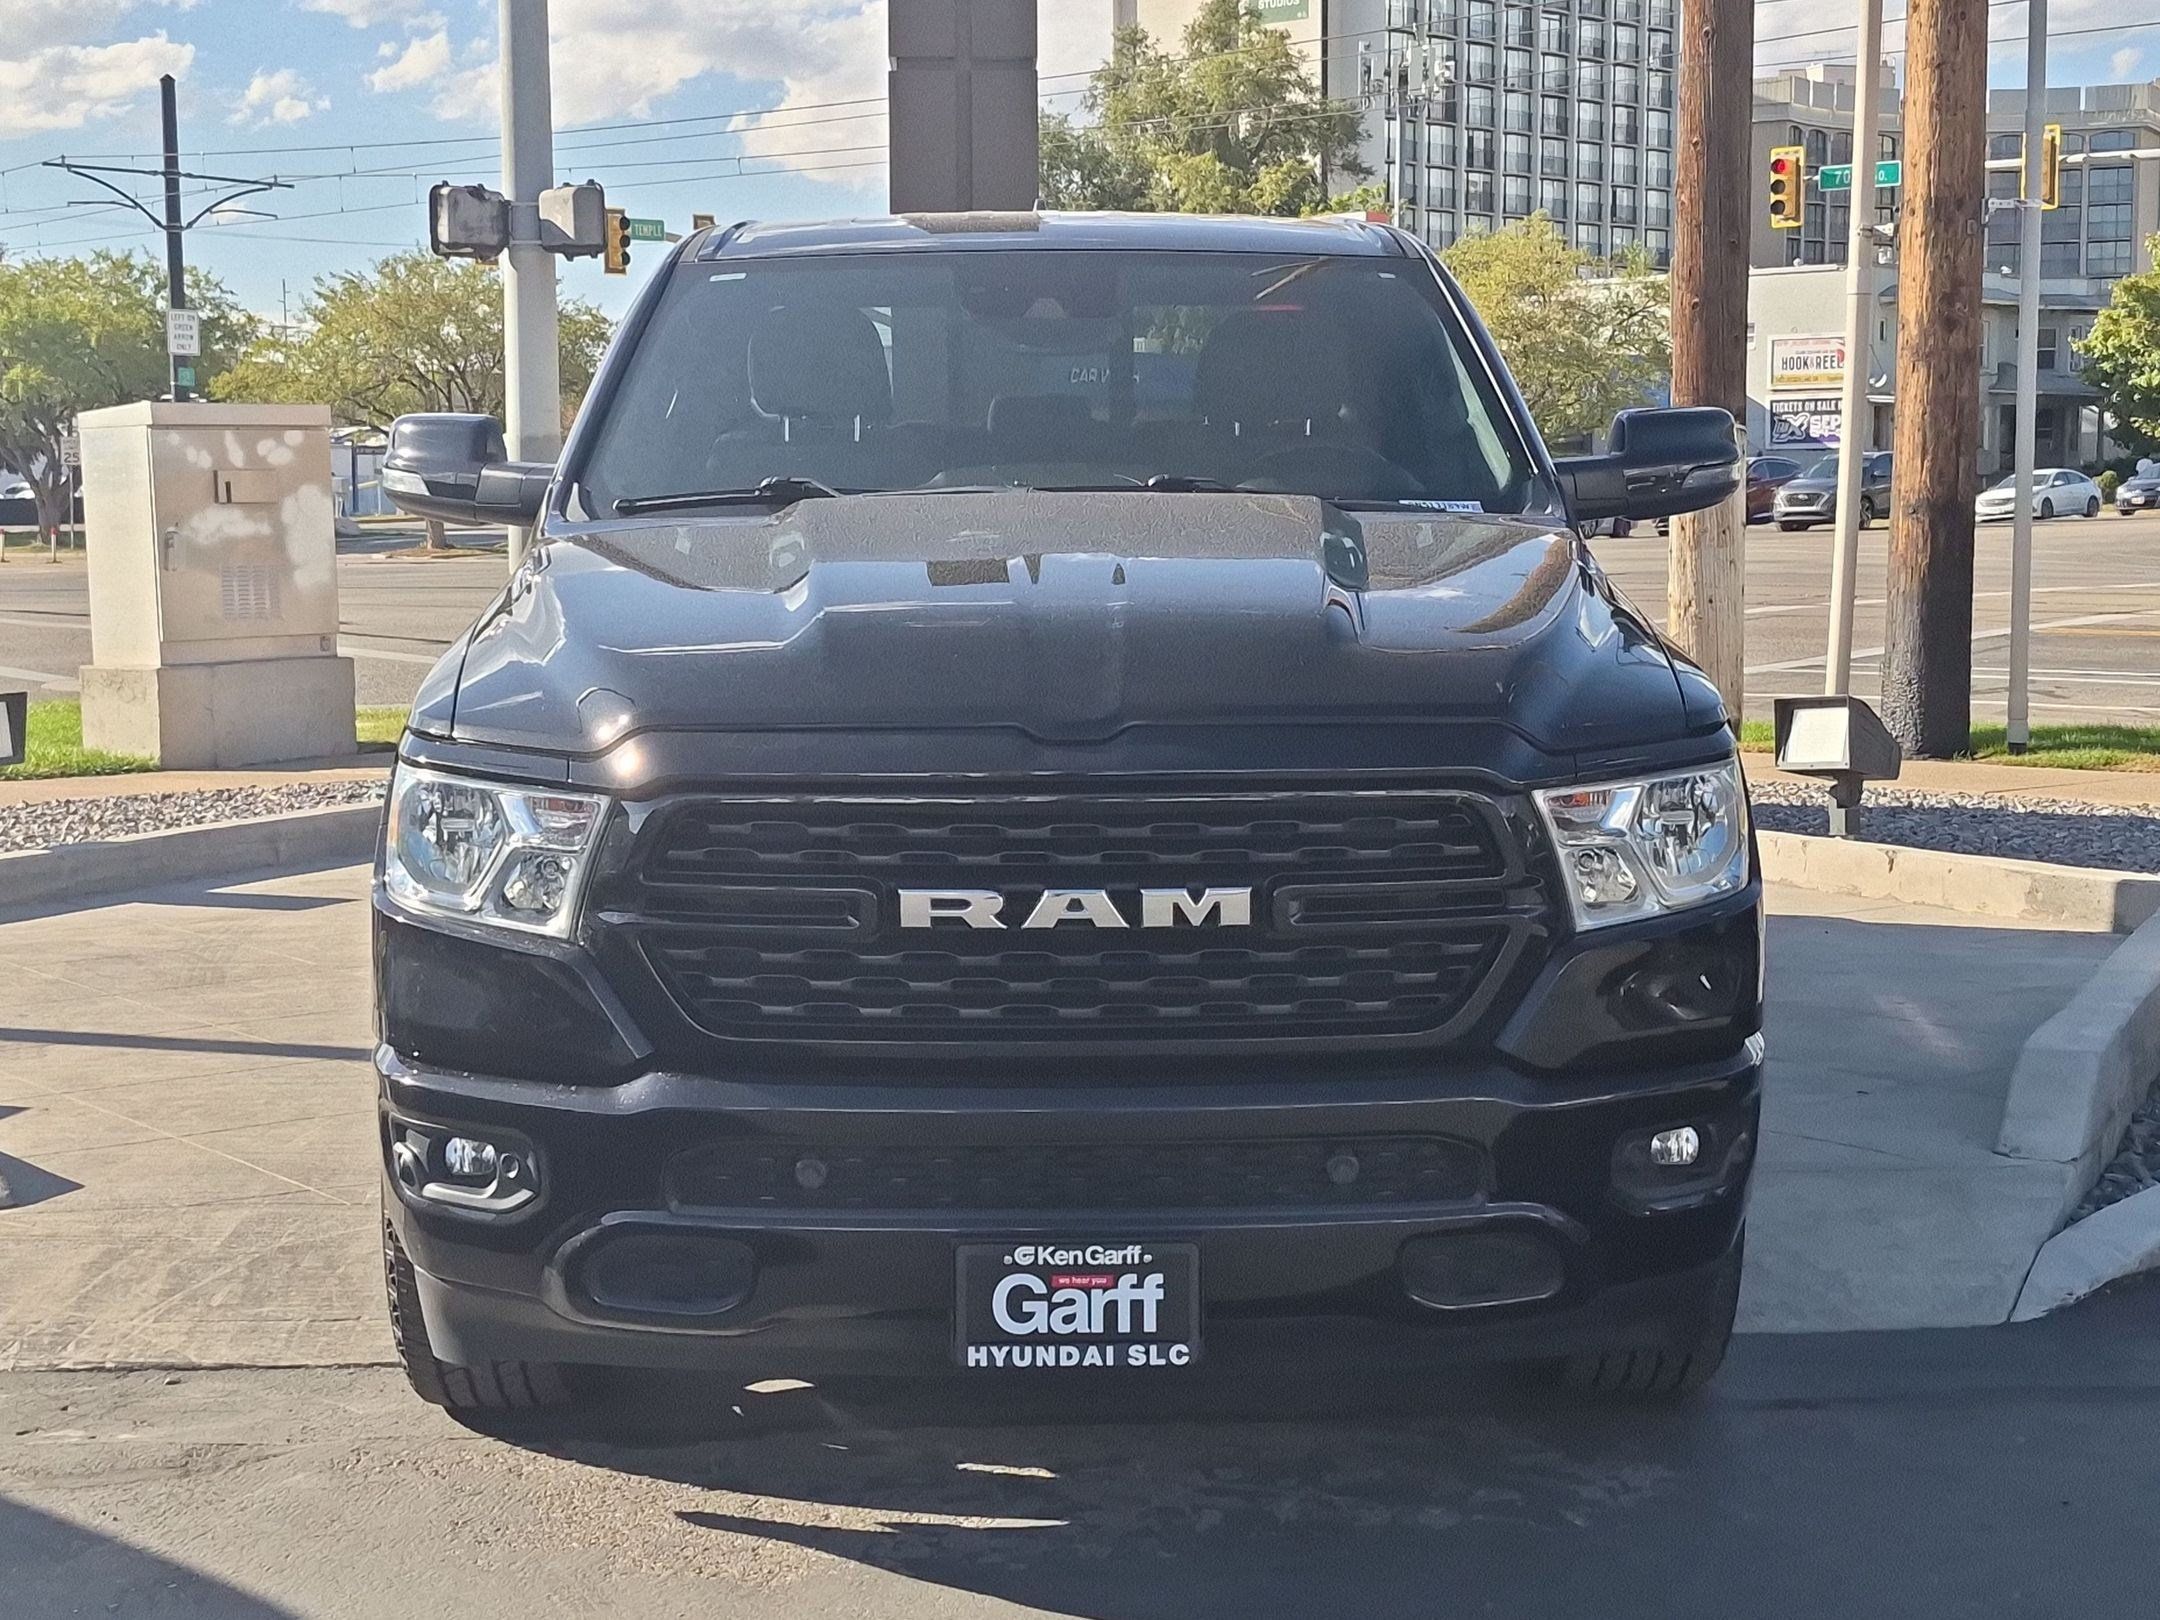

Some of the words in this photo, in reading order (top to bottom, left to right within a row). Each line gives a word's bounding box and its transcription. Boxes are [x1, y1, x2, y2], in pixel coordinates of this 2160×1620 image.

[634, 224, 662, 237] TEMPLE
[1781, 356, 1809, 371] HOOK
[1773, 401, 1803, 412] TICKETS
[1816, 400, 1836, 411] SALE
[64, 452, 80, 463] 25
[898, 888, 1252, 930] RAM
[1085, 1245, 1142, 1265] Garff
[992, 1273, 1164, 1335] Garff
[967, 1345, 1114, 1367] HYUNDAI
[1128, 1343, 1189, 1366] SLC
